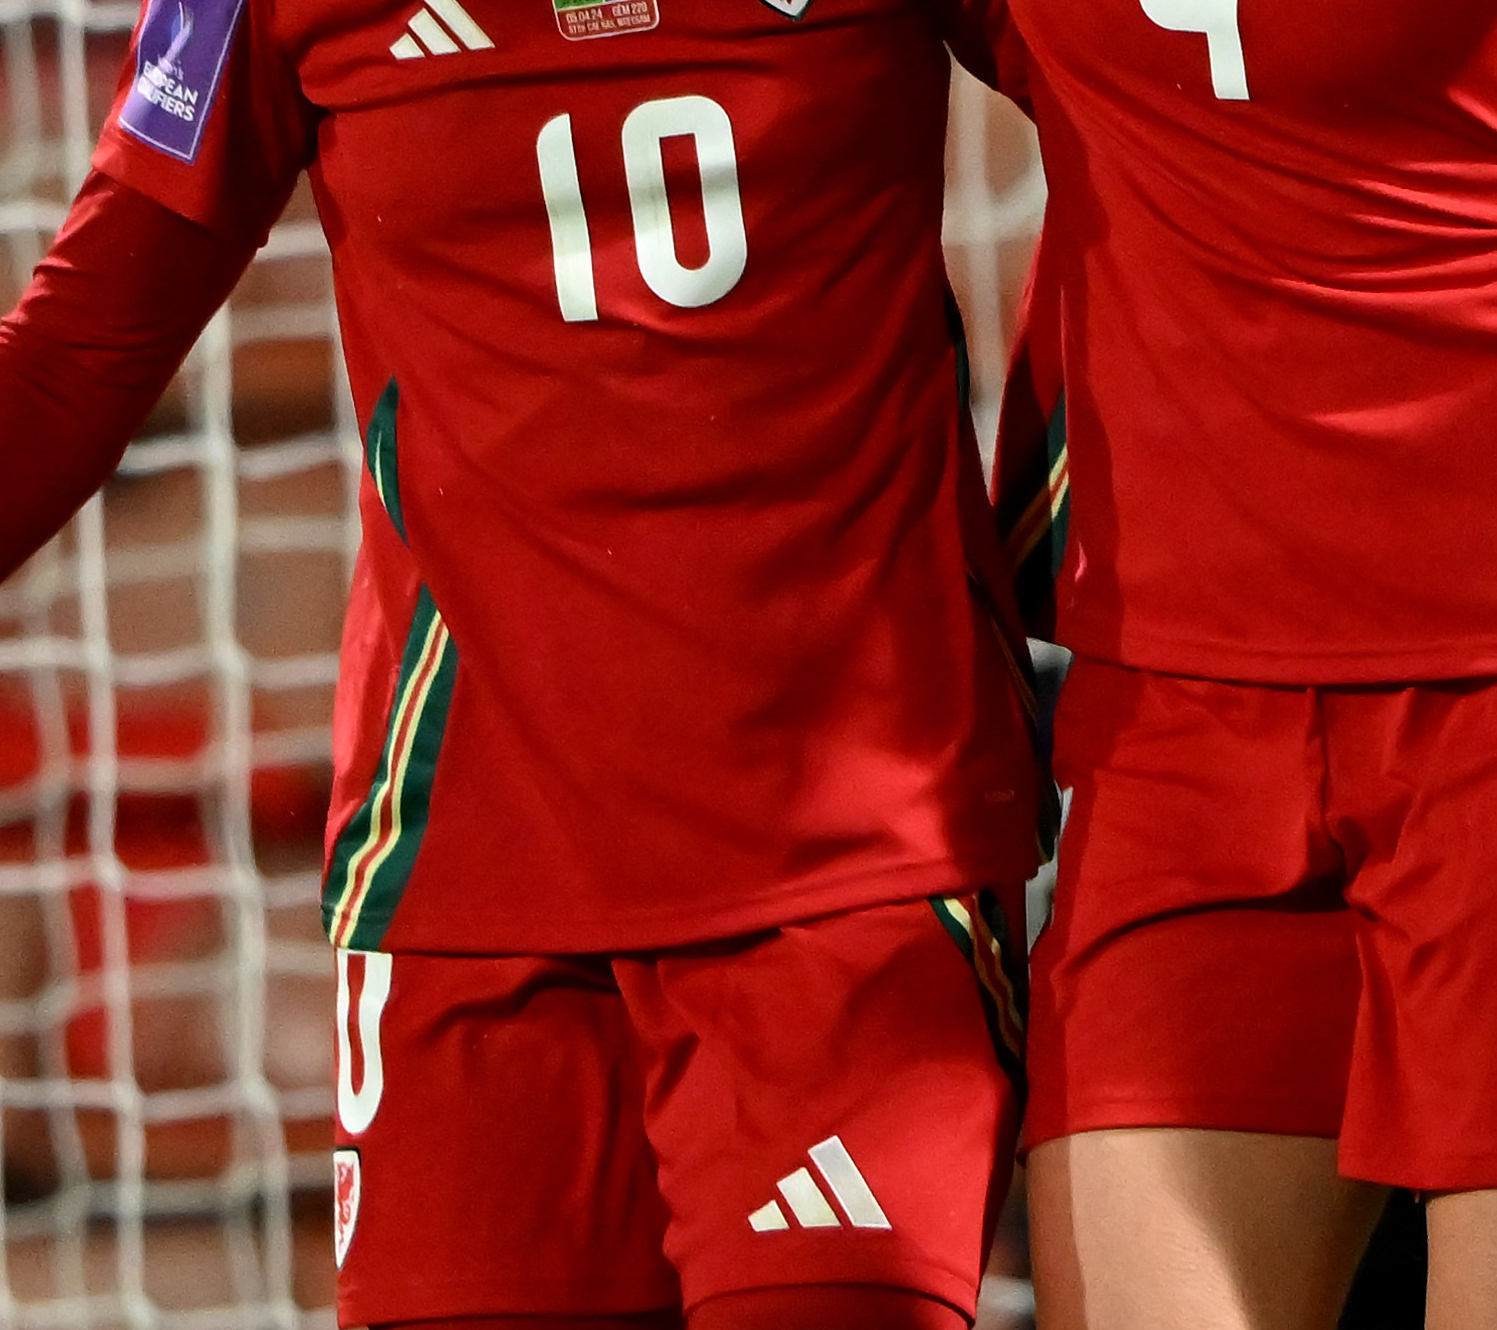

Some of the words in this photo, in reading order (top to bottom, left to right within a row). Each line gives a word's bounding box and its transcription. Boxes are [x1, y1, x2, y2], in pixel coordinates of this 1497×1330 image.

[137, 76, 196, 122] IFIERS
[143, 60, 199, 105] EPEAN
[535, 94, 749, 323] 10
